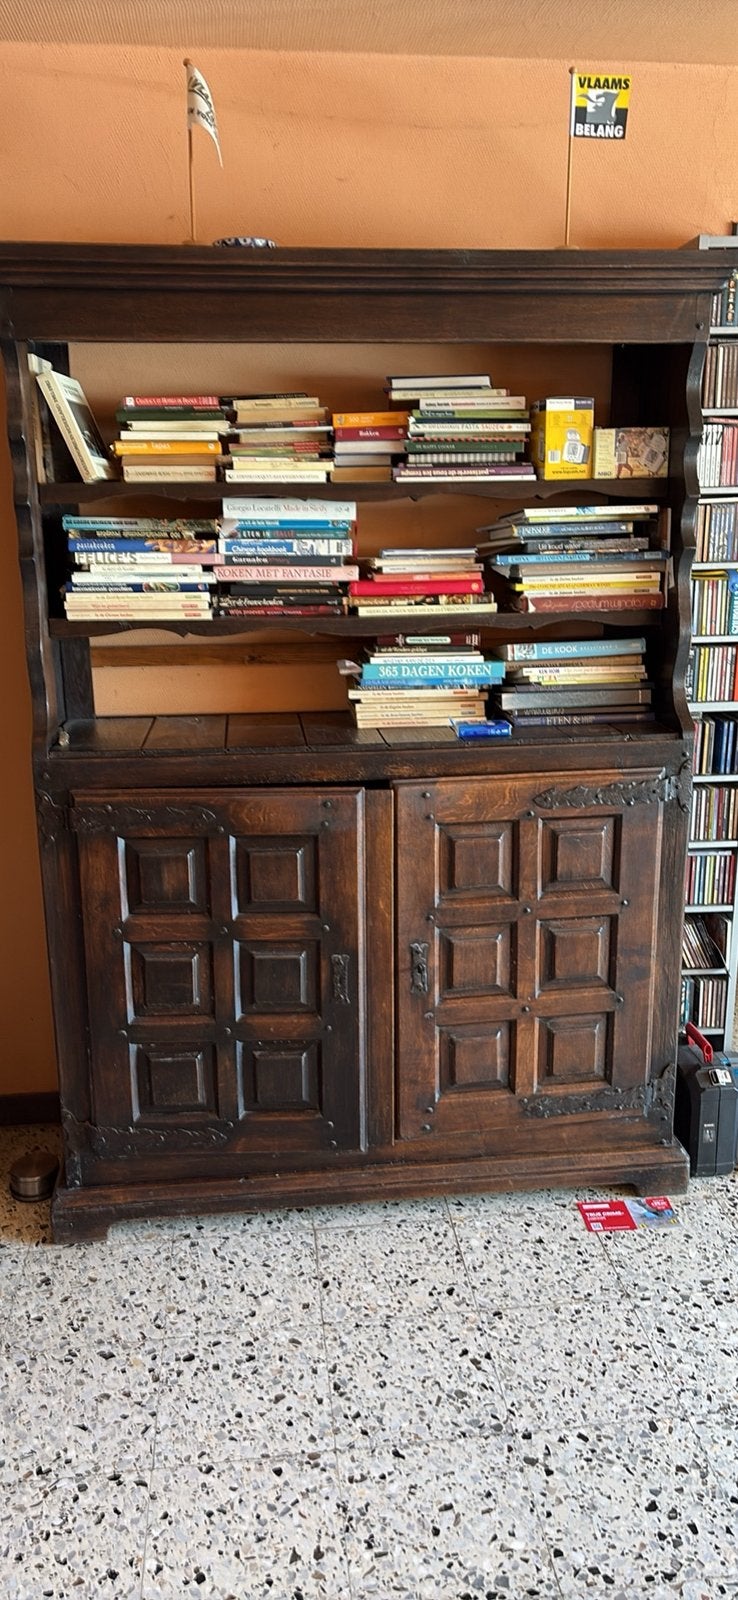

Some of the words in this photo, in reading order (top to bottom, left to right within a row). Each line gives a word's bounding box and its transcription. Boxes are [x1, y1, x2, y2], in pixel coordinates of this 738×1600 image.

[578, 76, 630, 90] VLAAMS
[575, 122, 624, 138] BELANG
[226, 504, 252, 513] Giorgio
[283, 503, 301, 512] Made
[76, 552, 138, 564] FELICE'S
[217, 568, 253, 578] KOKEN
[255, 568, 279, 578] MET
[282, 568, 332, 578] FANTASIE
[541, 646, 553, 654] DE
[554, 645, 578, 654] KOOK
[378, 665, 399, 678] 365
[401, 664, 446, 677] DAGEN
[448, 664, 492, 676] KOKEN
